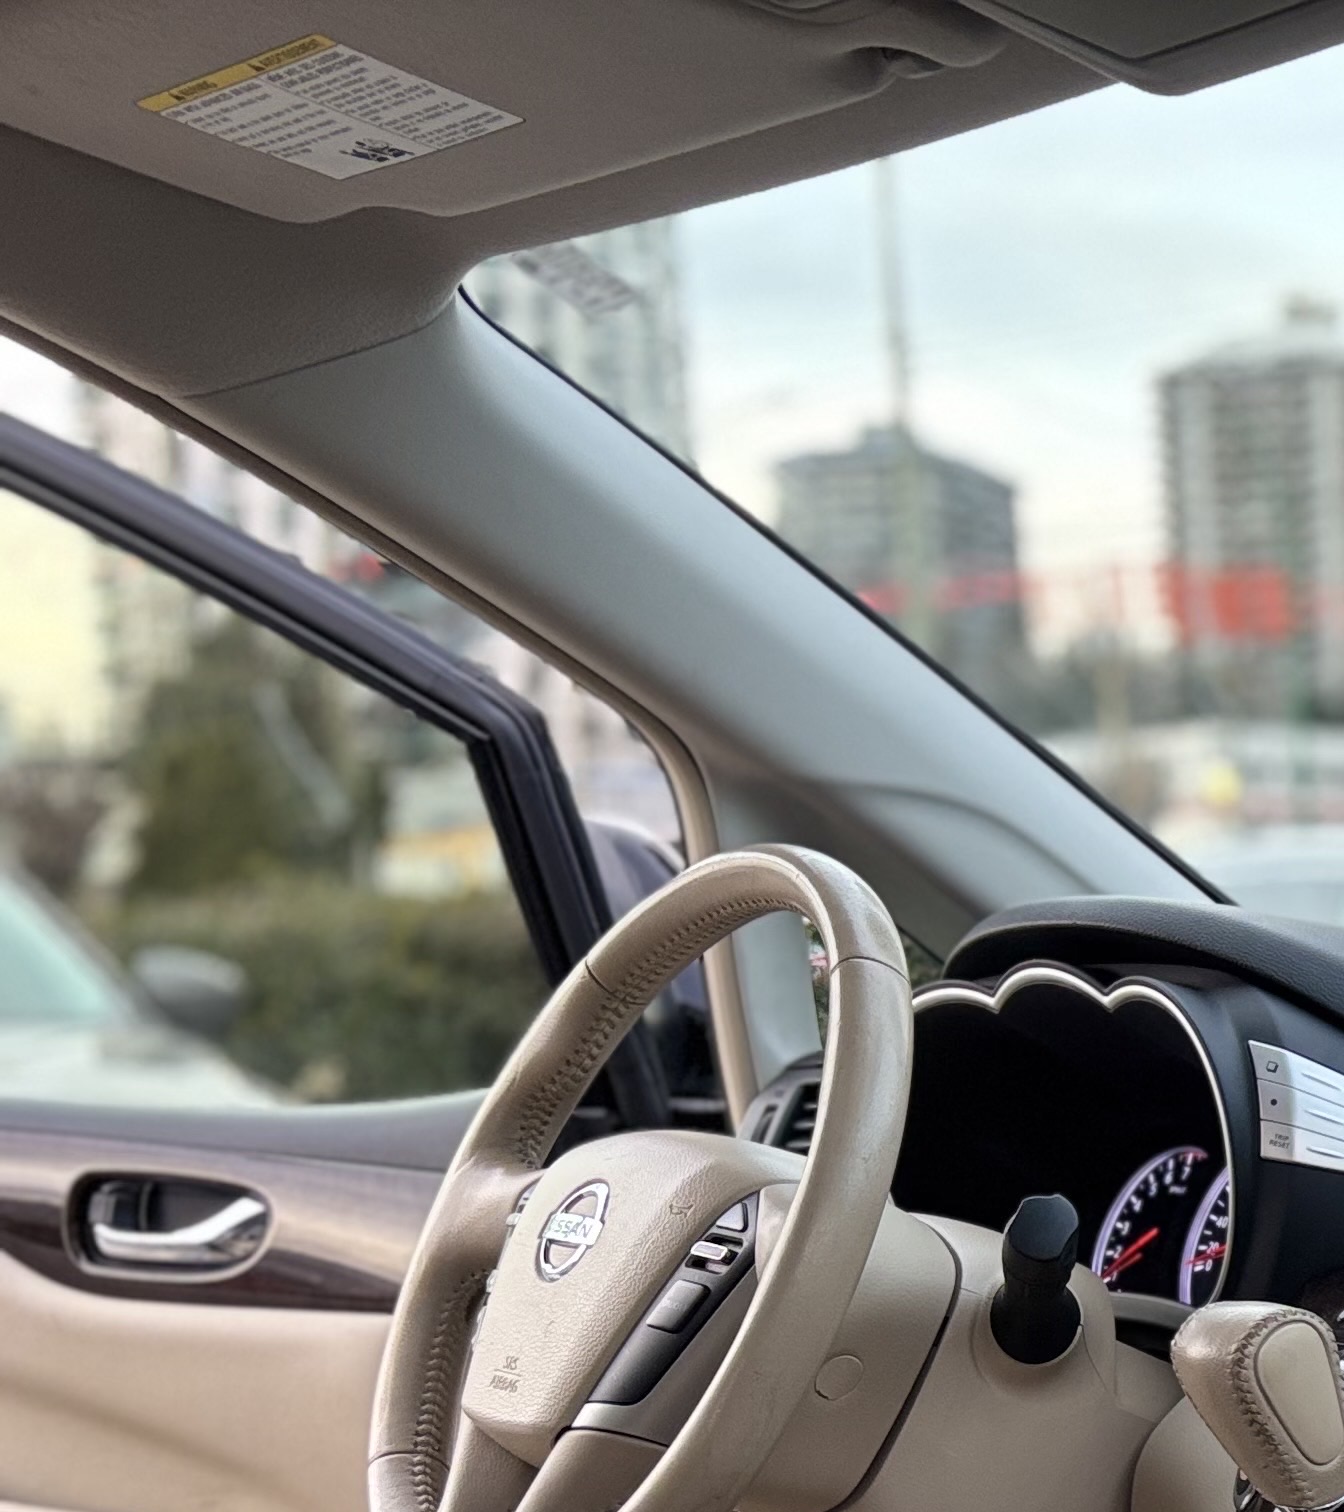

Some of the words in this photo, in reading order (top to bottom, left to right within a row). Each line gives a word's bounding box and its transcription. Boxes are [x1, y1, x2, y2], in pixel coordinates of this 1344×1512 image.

[1274, 1133, 1291, 1142] TRIP
[1268, 1139, 1291, 1150] RESET
[546, 1217, 593, 1239] SSAN
[1215, 1215, 1229, 1228] 40
[1204, 1259, 1213, 1272] 0
